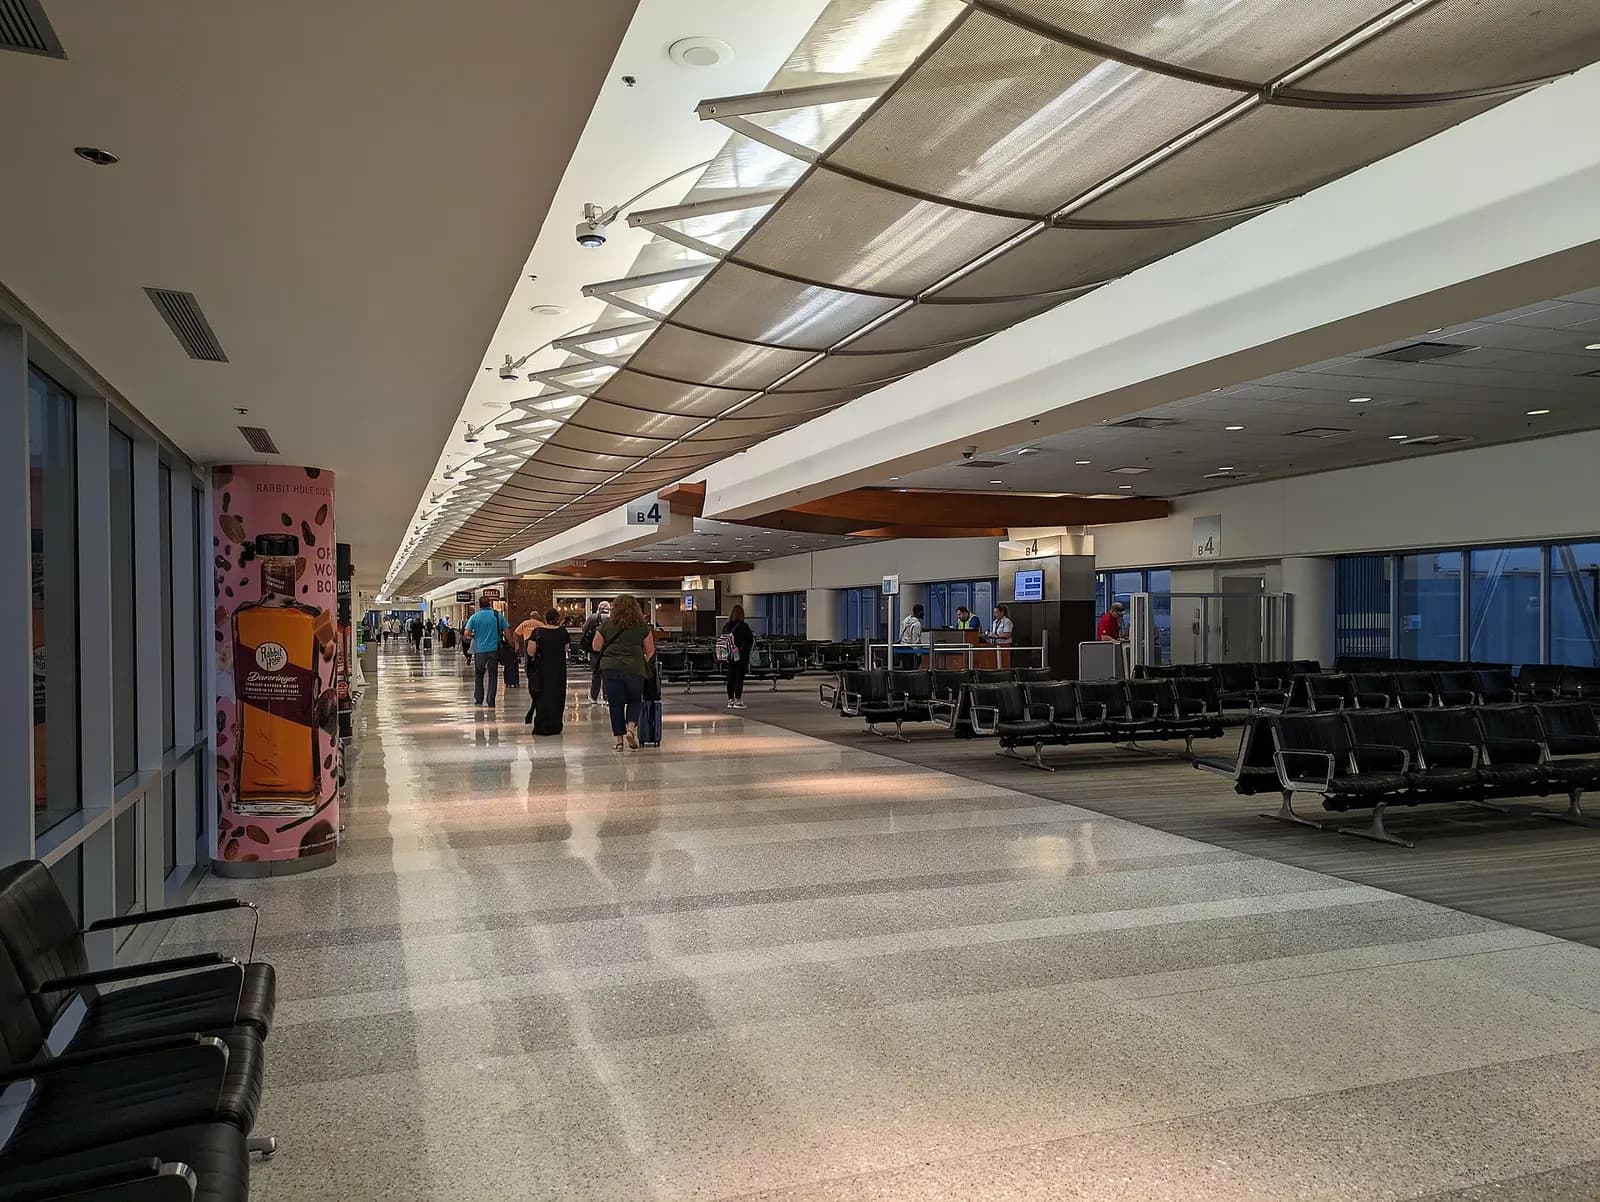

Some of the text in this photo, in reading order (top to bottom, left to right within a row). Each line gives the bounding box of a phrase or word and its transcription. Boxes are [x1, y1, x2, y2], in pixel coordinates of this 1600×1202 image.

[256, 483, 290, 494] RABBIT
[293, 485, 314, 496] HOLE
[260, 646, 283, 662] Rabbit
